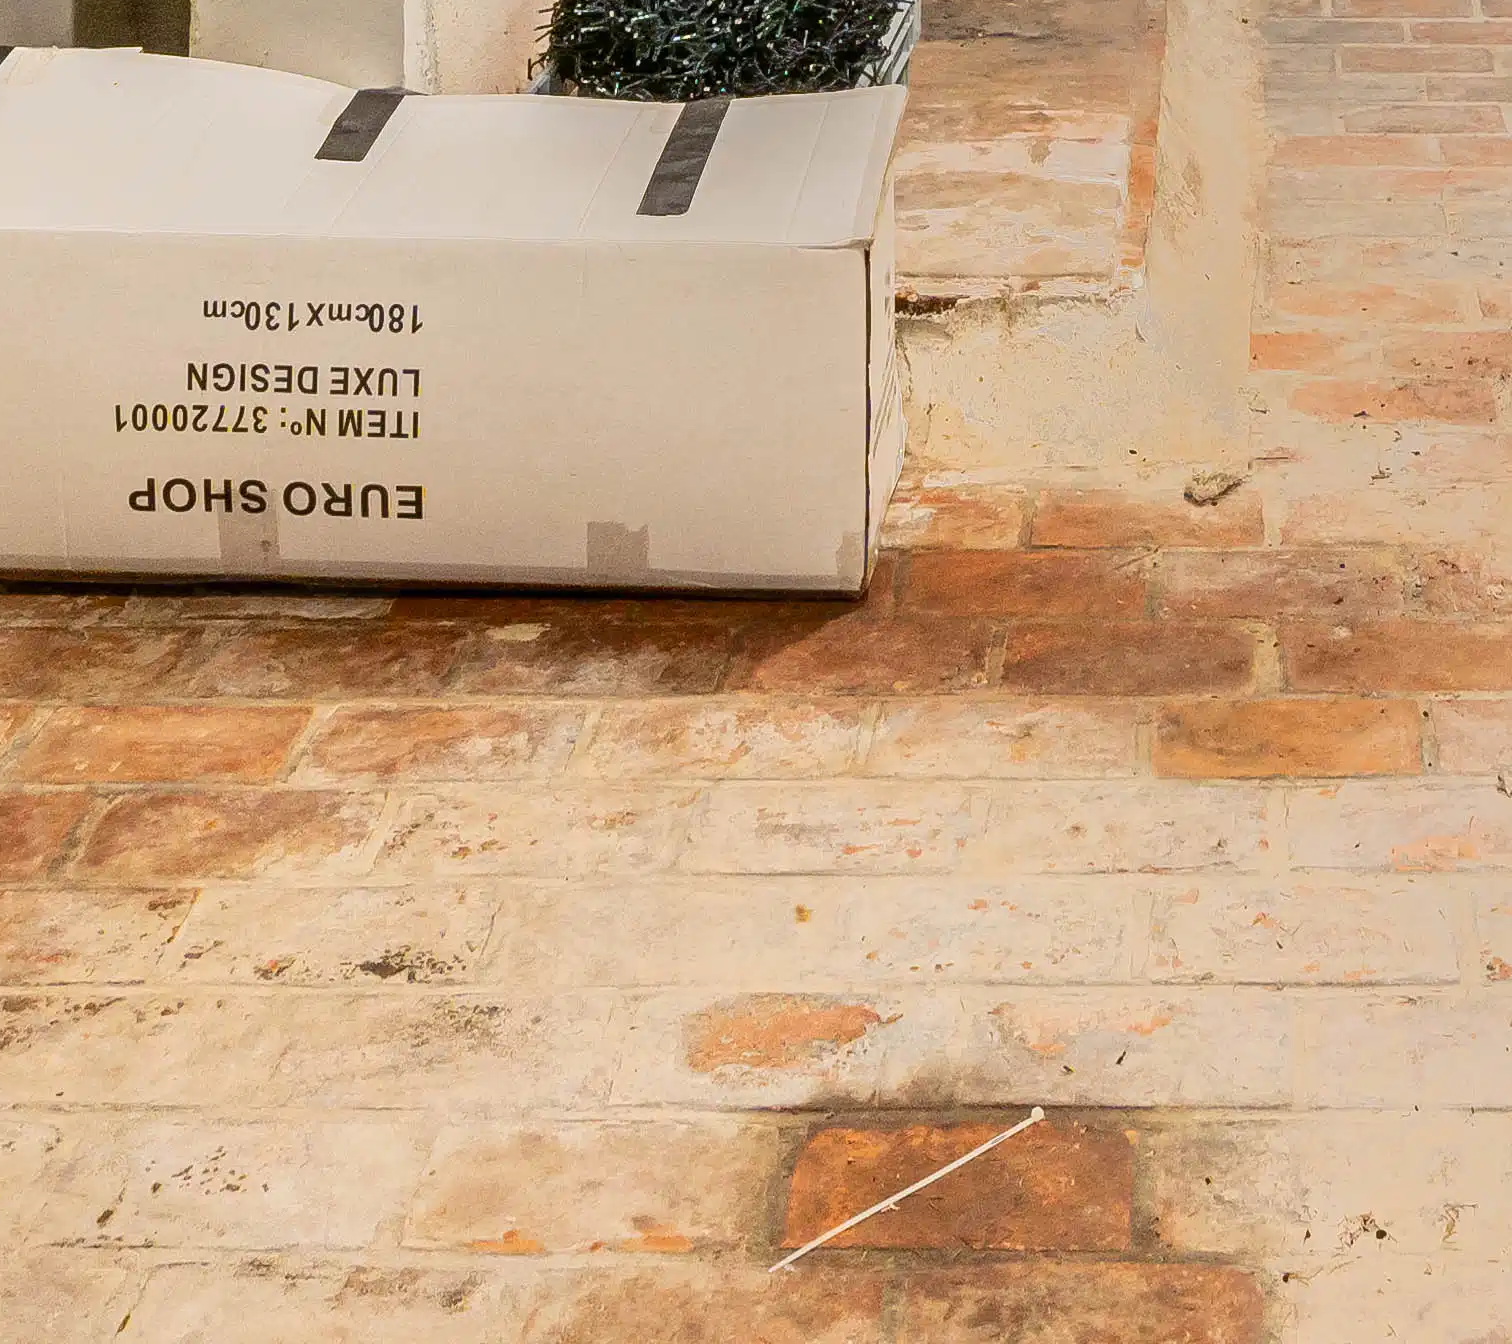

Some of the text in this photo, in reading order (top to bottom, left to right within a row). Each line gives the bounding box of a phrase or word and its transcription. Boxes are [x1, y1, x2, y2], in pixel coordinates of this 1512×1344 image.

[187, 362, 420, 398] LUXE DESIGN
[115, 403, 268, 434] 37720001
[338, 409, 419, 439] ITEM
[128, 477, 424, 520] EURO SHOP
